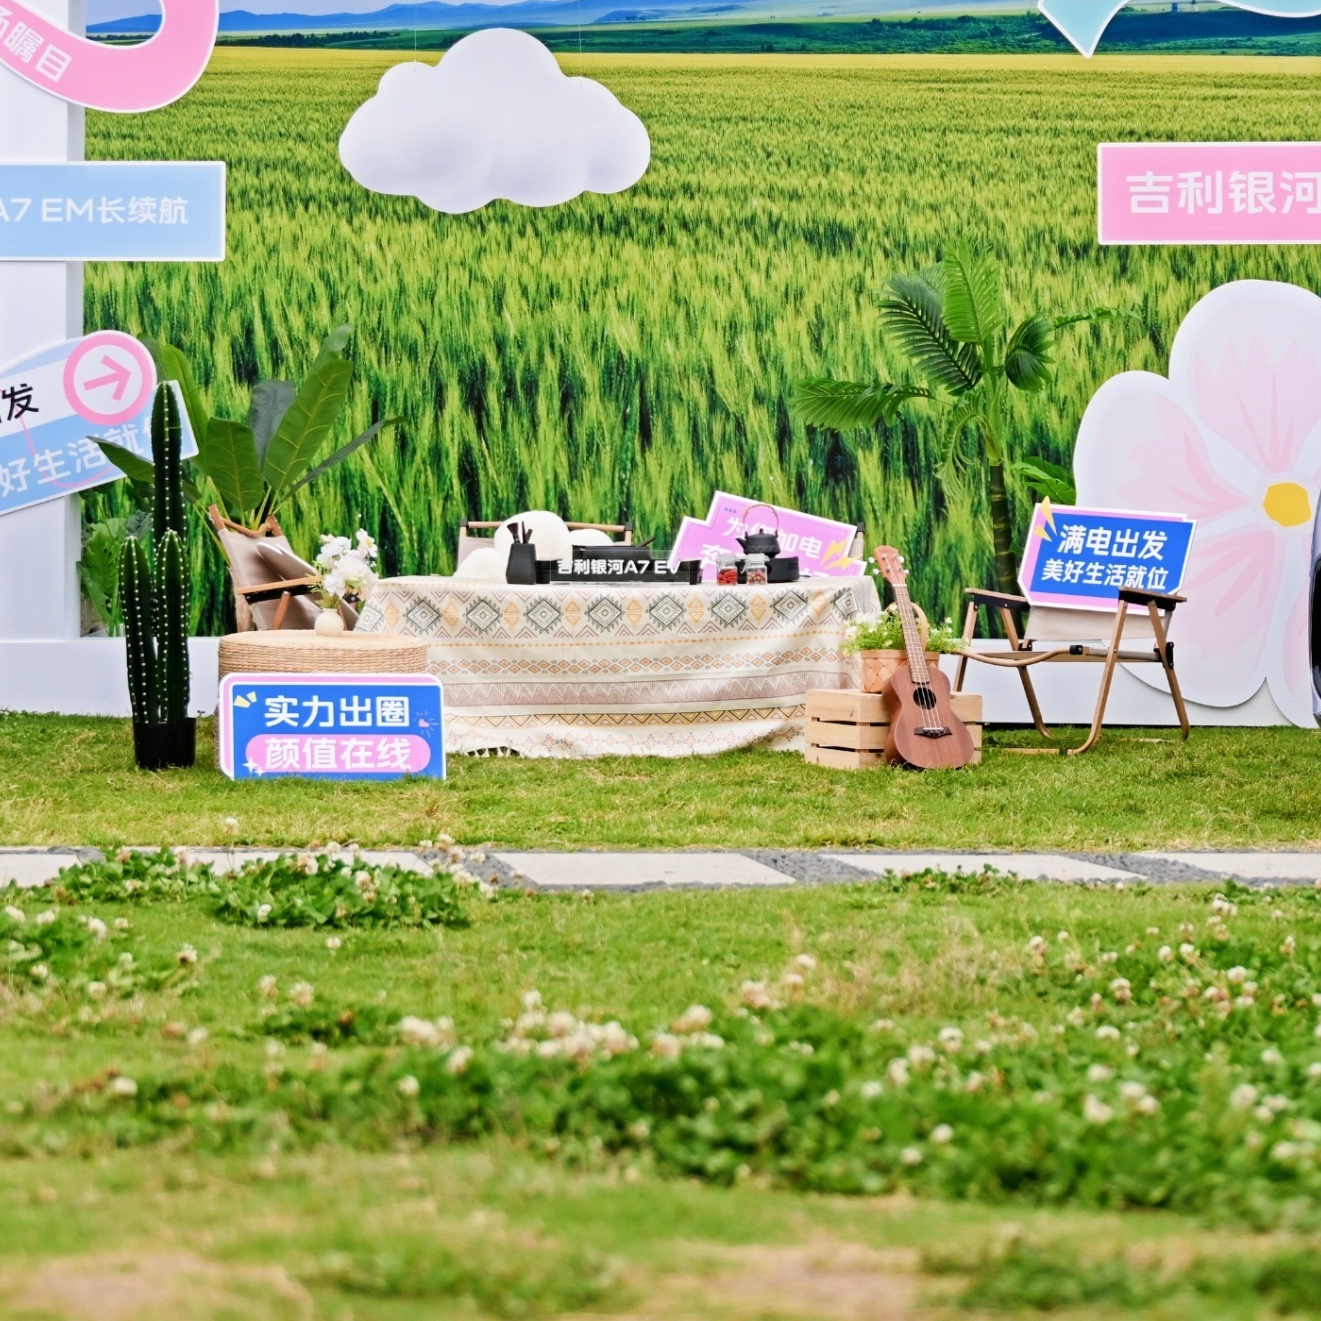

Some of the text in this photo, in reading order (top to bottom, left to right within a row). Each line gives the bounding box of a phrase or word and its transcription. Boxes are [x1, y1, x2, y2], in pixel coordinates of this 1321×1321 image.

[41, 196, 190, 225] EM长续航
[1057, 523, 1168, 561] 满电出发
[557, 558, 650, 575] 吉利银河A7
[1041, 557, 1169, 591] 美好生活就位
[264, 695, 410, 727] 实力出圈
[265, 737, 411, 770] 颜值在线
